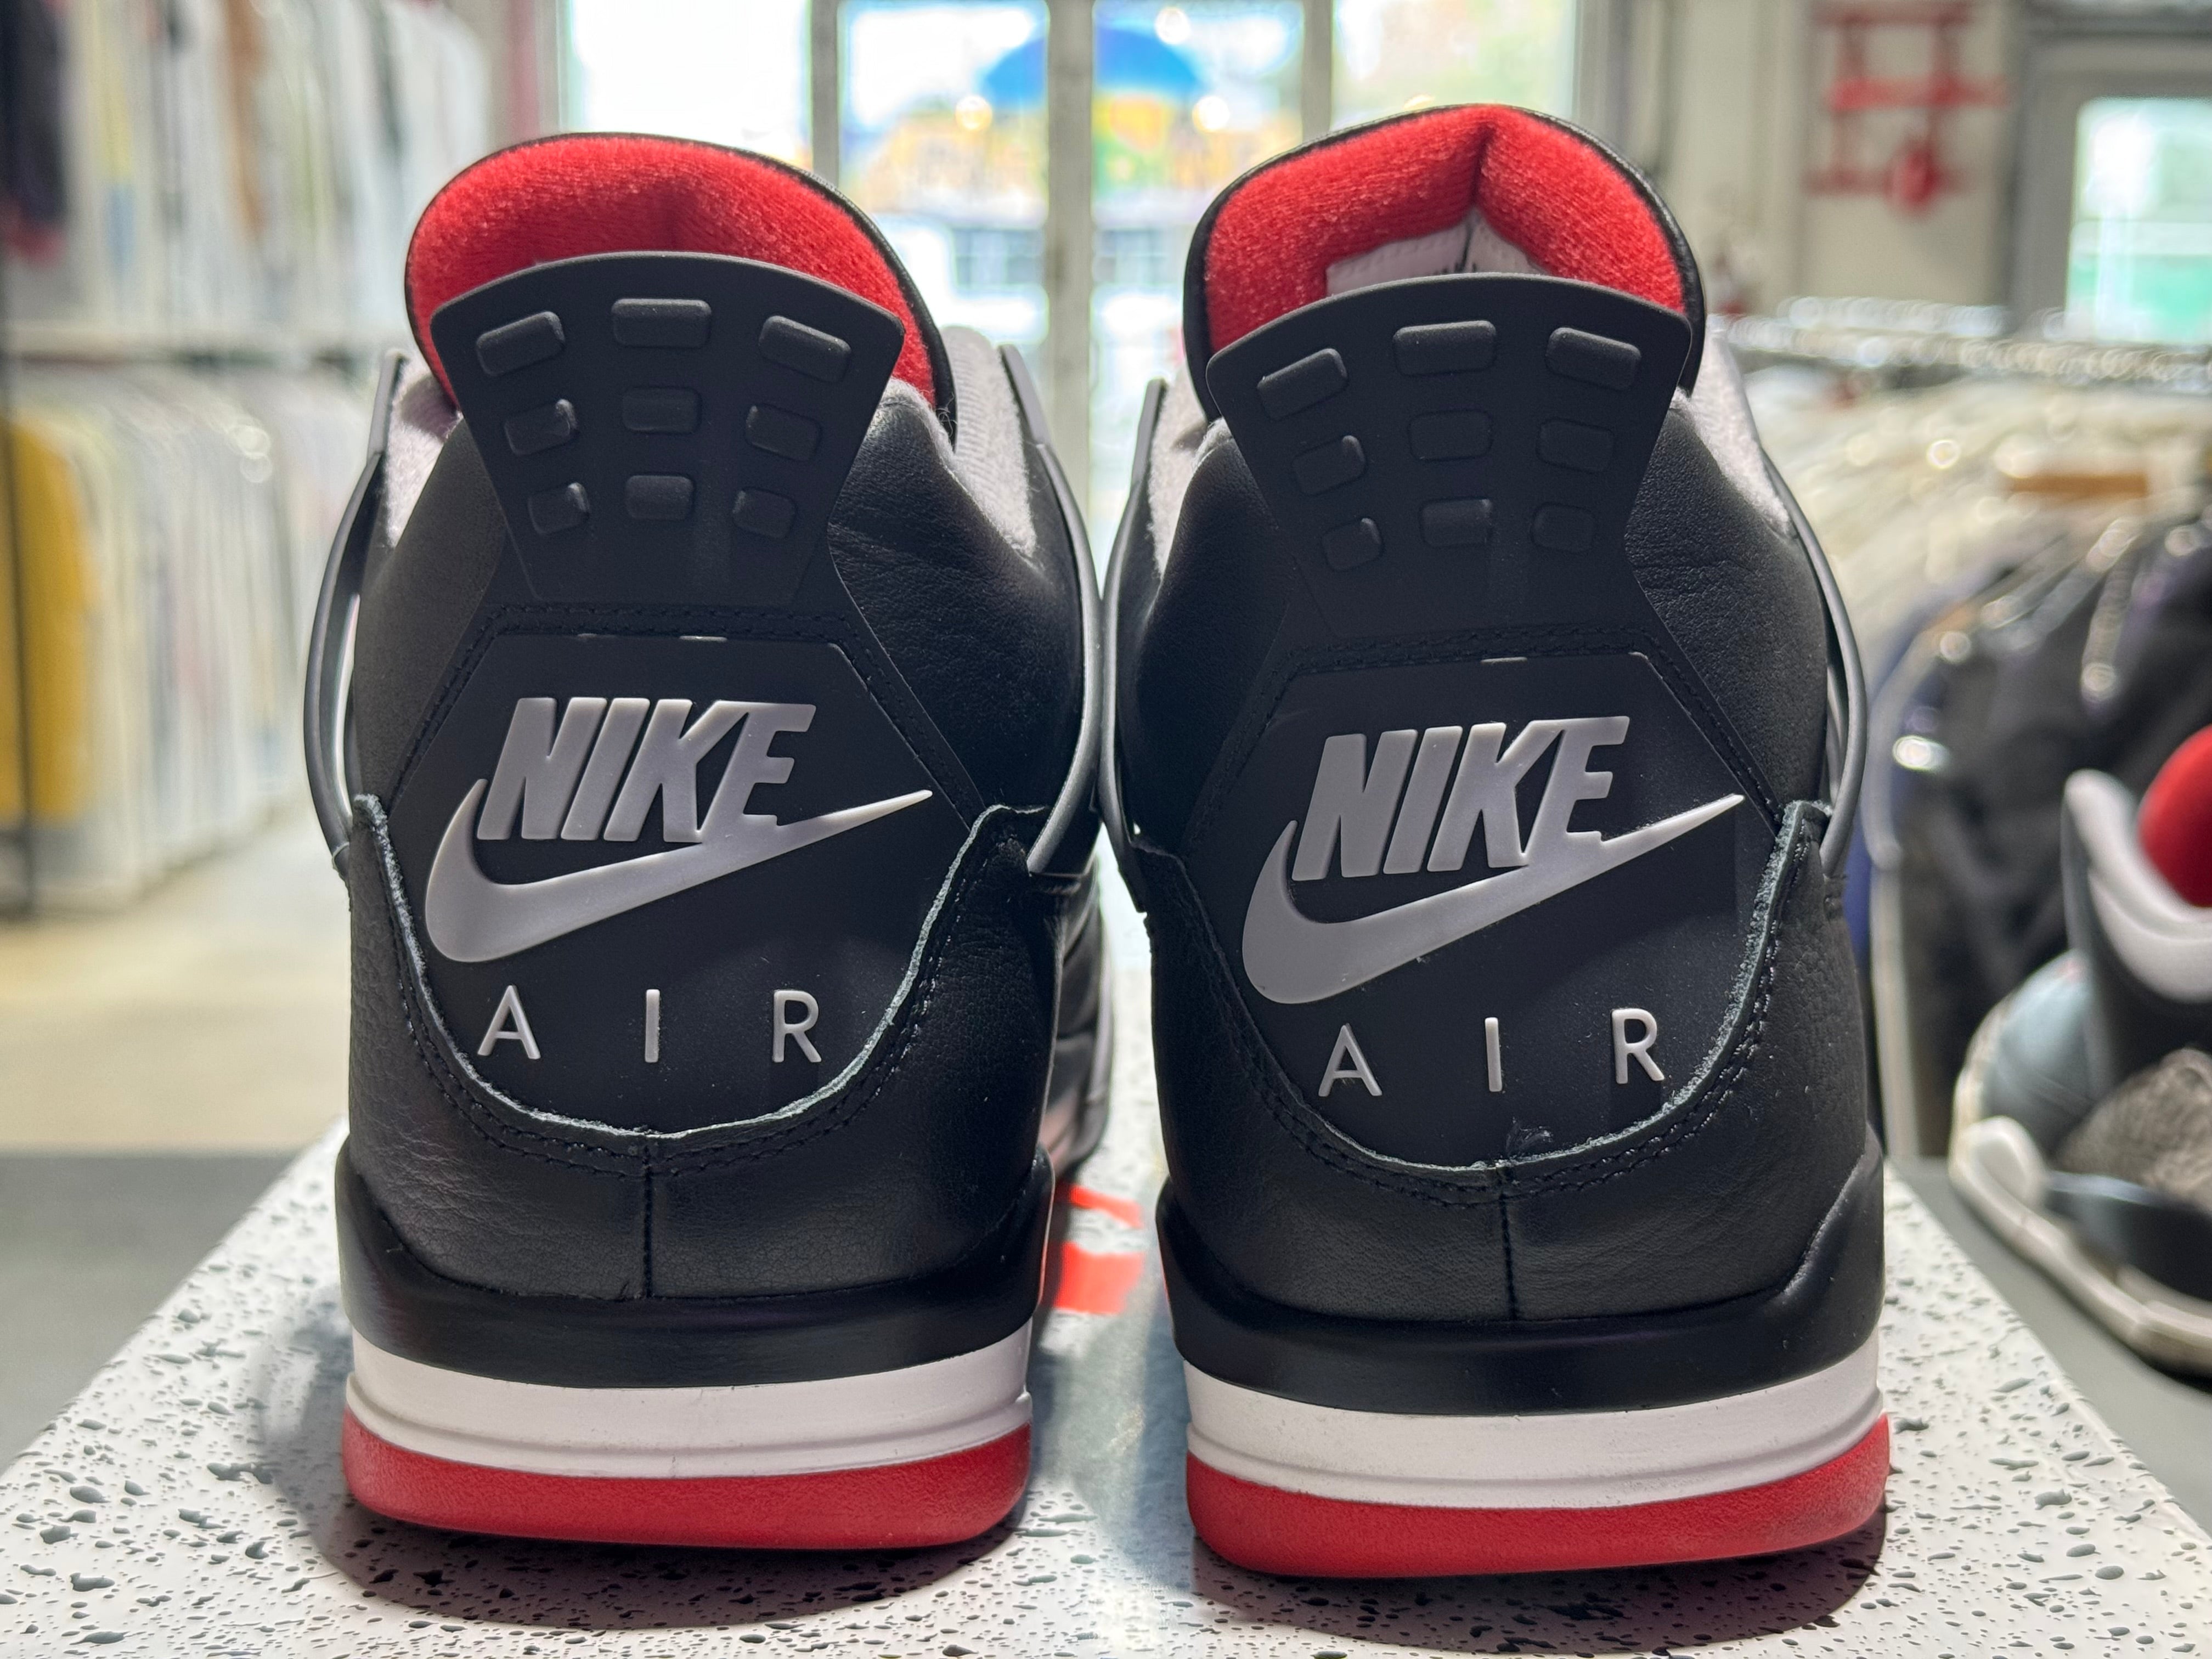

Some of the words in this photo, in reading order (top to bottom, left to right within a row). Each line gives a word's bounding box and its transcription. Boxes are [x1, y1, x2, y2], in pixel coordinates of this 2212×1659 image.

[477, 697, 816, 843] NIKE
[1291, 716, 1630, 881] NIKE
[477, 985, 822, 1063] AIR
[1318, 1007, 1666, 1097] AIR
